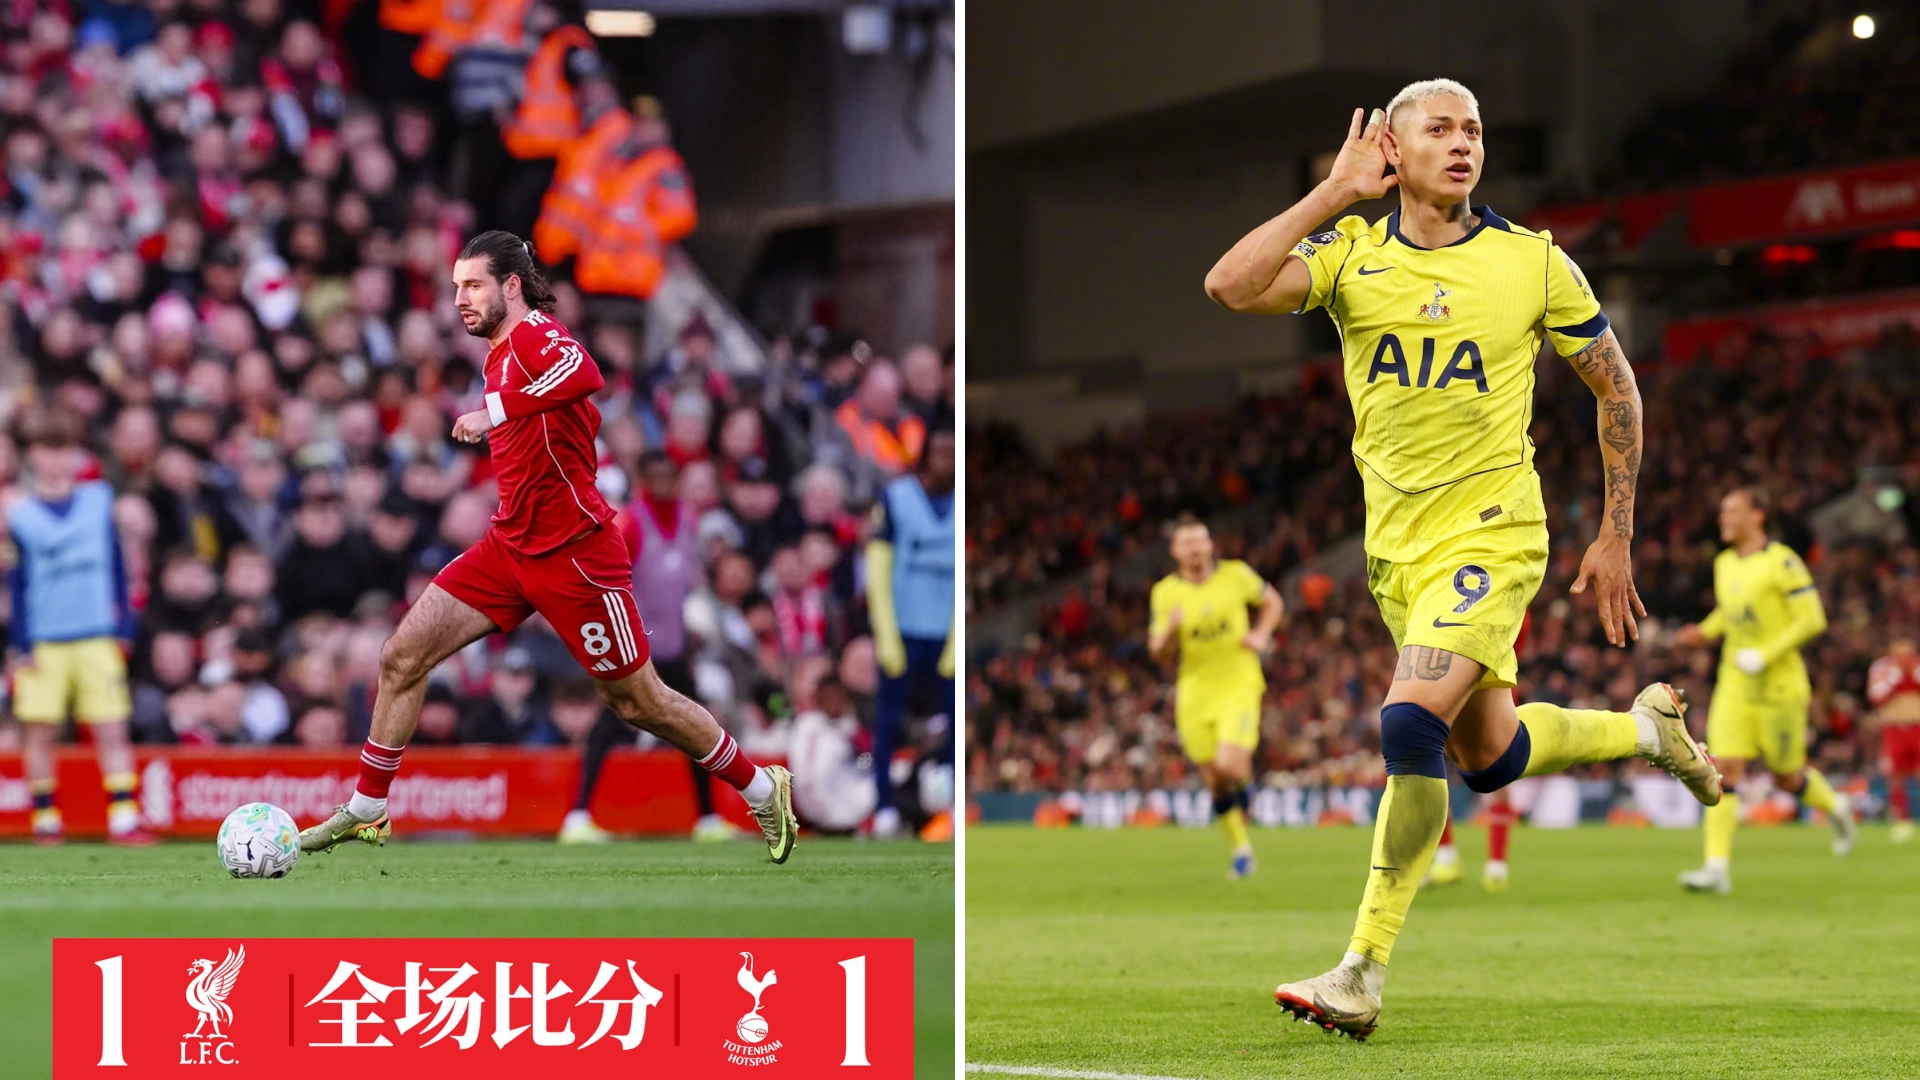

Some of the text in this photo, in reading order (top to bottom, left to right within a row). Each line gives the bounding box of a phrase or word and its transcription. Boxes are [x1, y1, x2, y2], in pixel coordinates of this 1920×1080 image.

[1366, 333, 1490, 393] AIA
[1452, 564, 1491, 614] 9
[580, 621, 612, 656] 8
